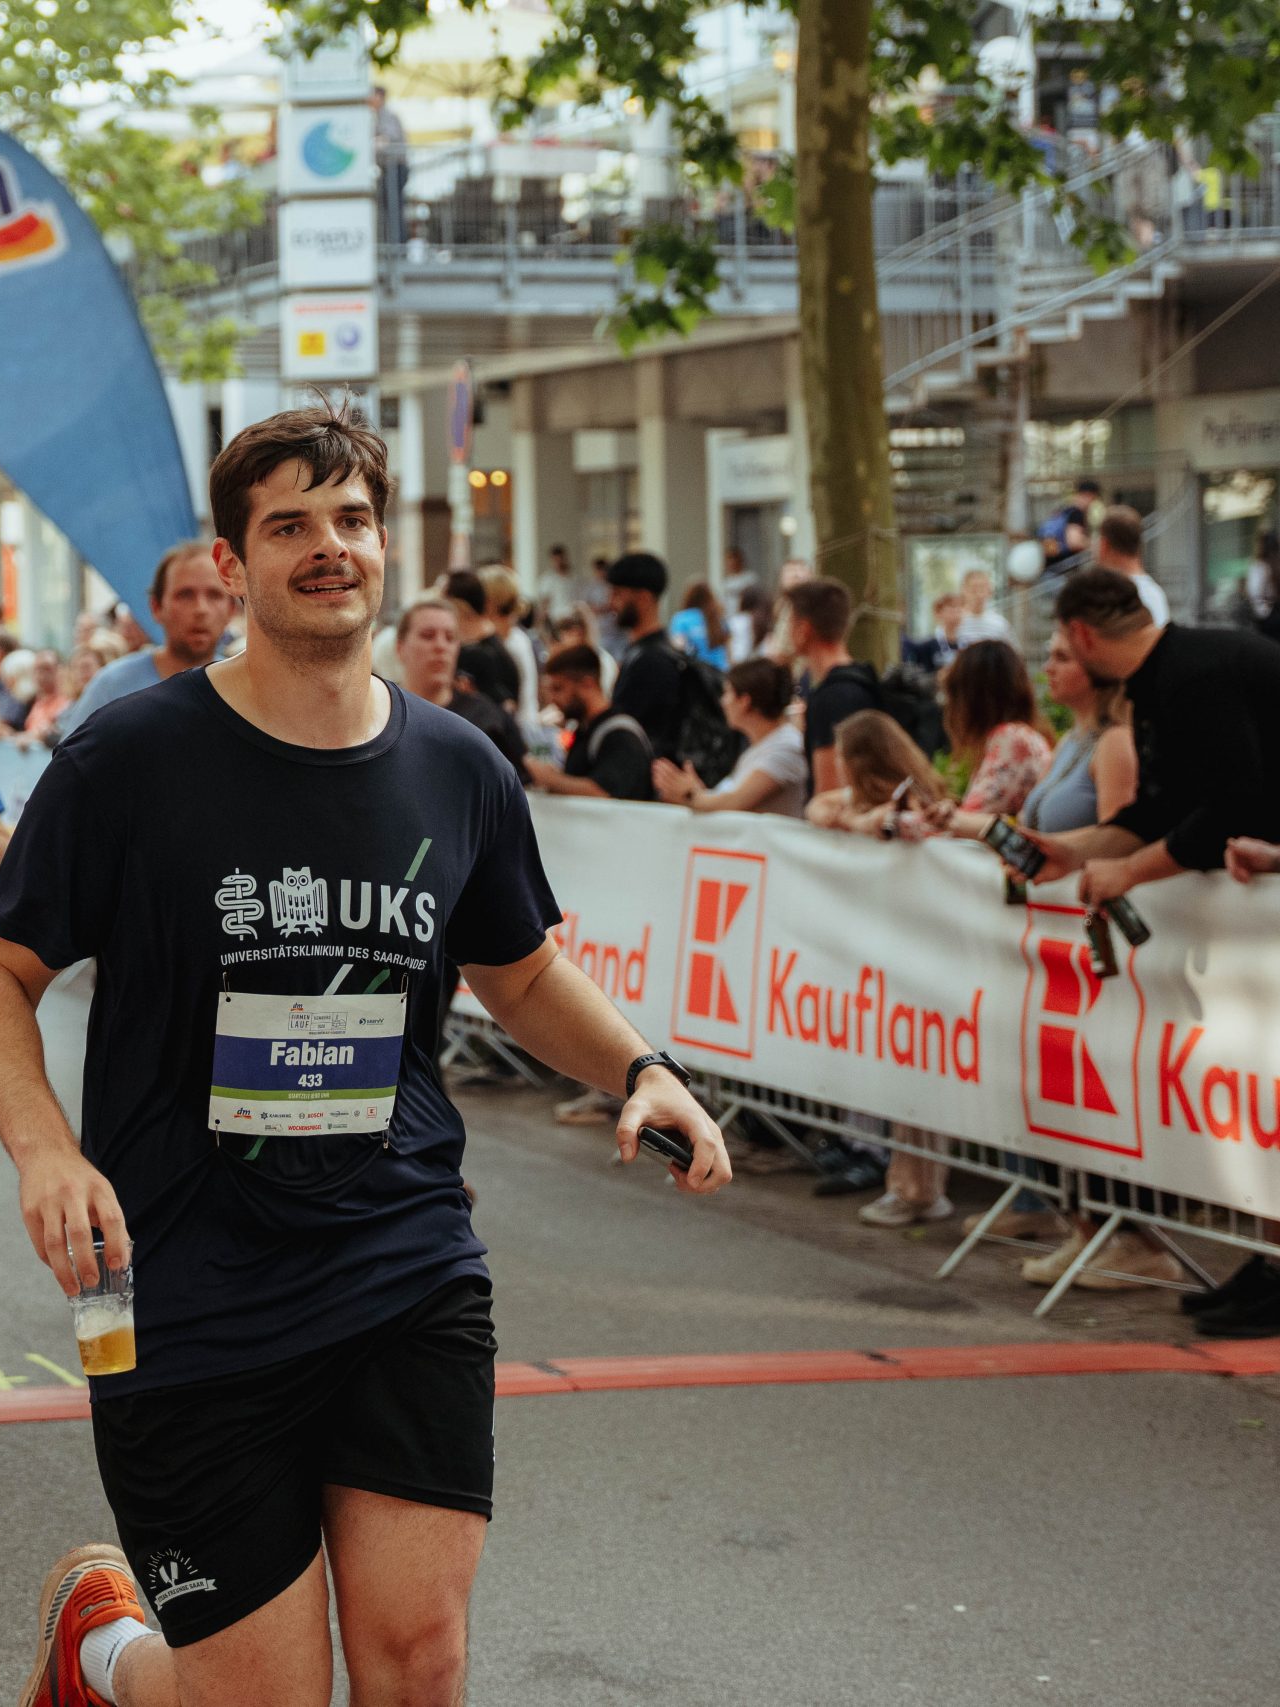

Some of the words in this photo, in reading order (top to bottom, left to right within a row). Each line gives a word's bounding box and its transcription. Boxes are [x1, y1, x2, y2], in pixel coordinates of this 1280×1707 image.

[339, 879, 436, 943] UKS
[220, 945, 344, 966] UNIVERSITÄTSKLINIKUM
[347, 946, 370, 960] DES
[372, 950, 428, 971] SAARLANDES
[290, 1020, 309, 1029] LAUF
[767, 947, 987, 1085] Kaufland
[270, 1041, 355, 1067] Fabian
[298, 1073, 323, 1087] 433
[190, 1581, 205, 1589] SAAR
